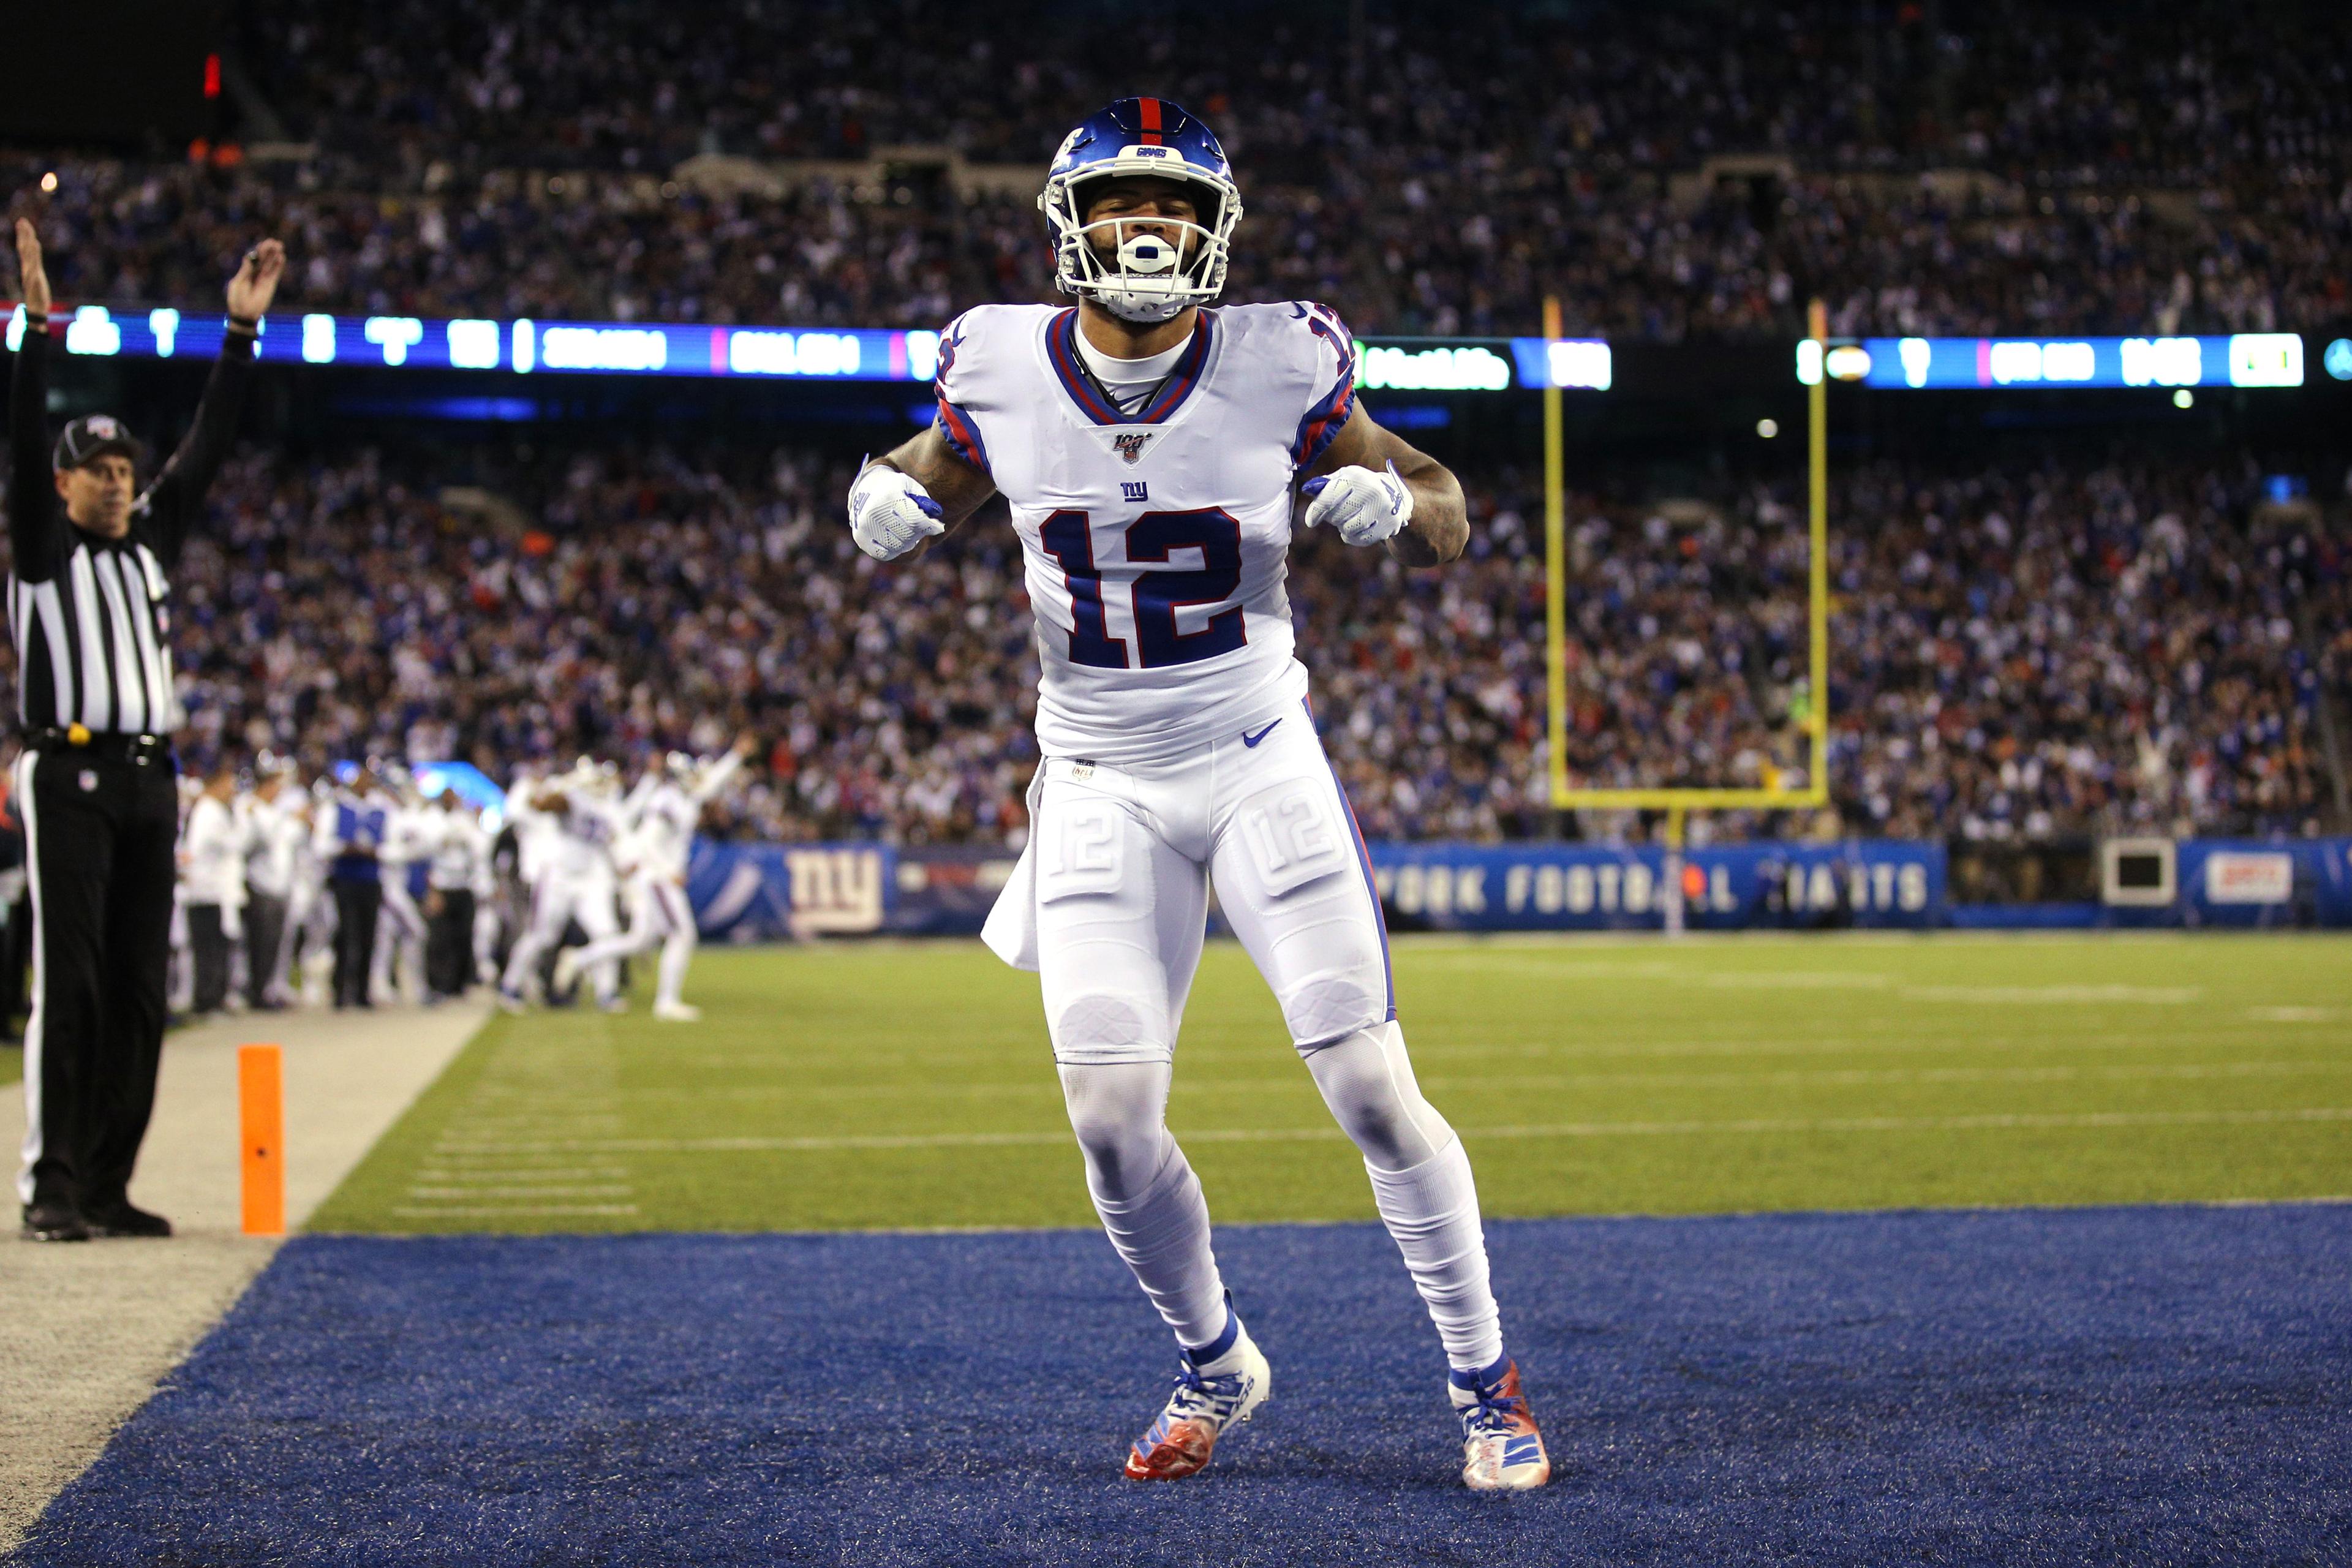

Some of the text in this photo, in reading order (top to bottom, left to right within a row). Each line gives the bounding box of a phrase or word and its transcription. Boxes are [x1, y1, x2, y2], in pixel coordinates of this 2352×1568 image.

[1039, 505, 1248, 669] 12
[1048, 807, 1114, 877] 12
[1251, 792, 1335, 873] 12
